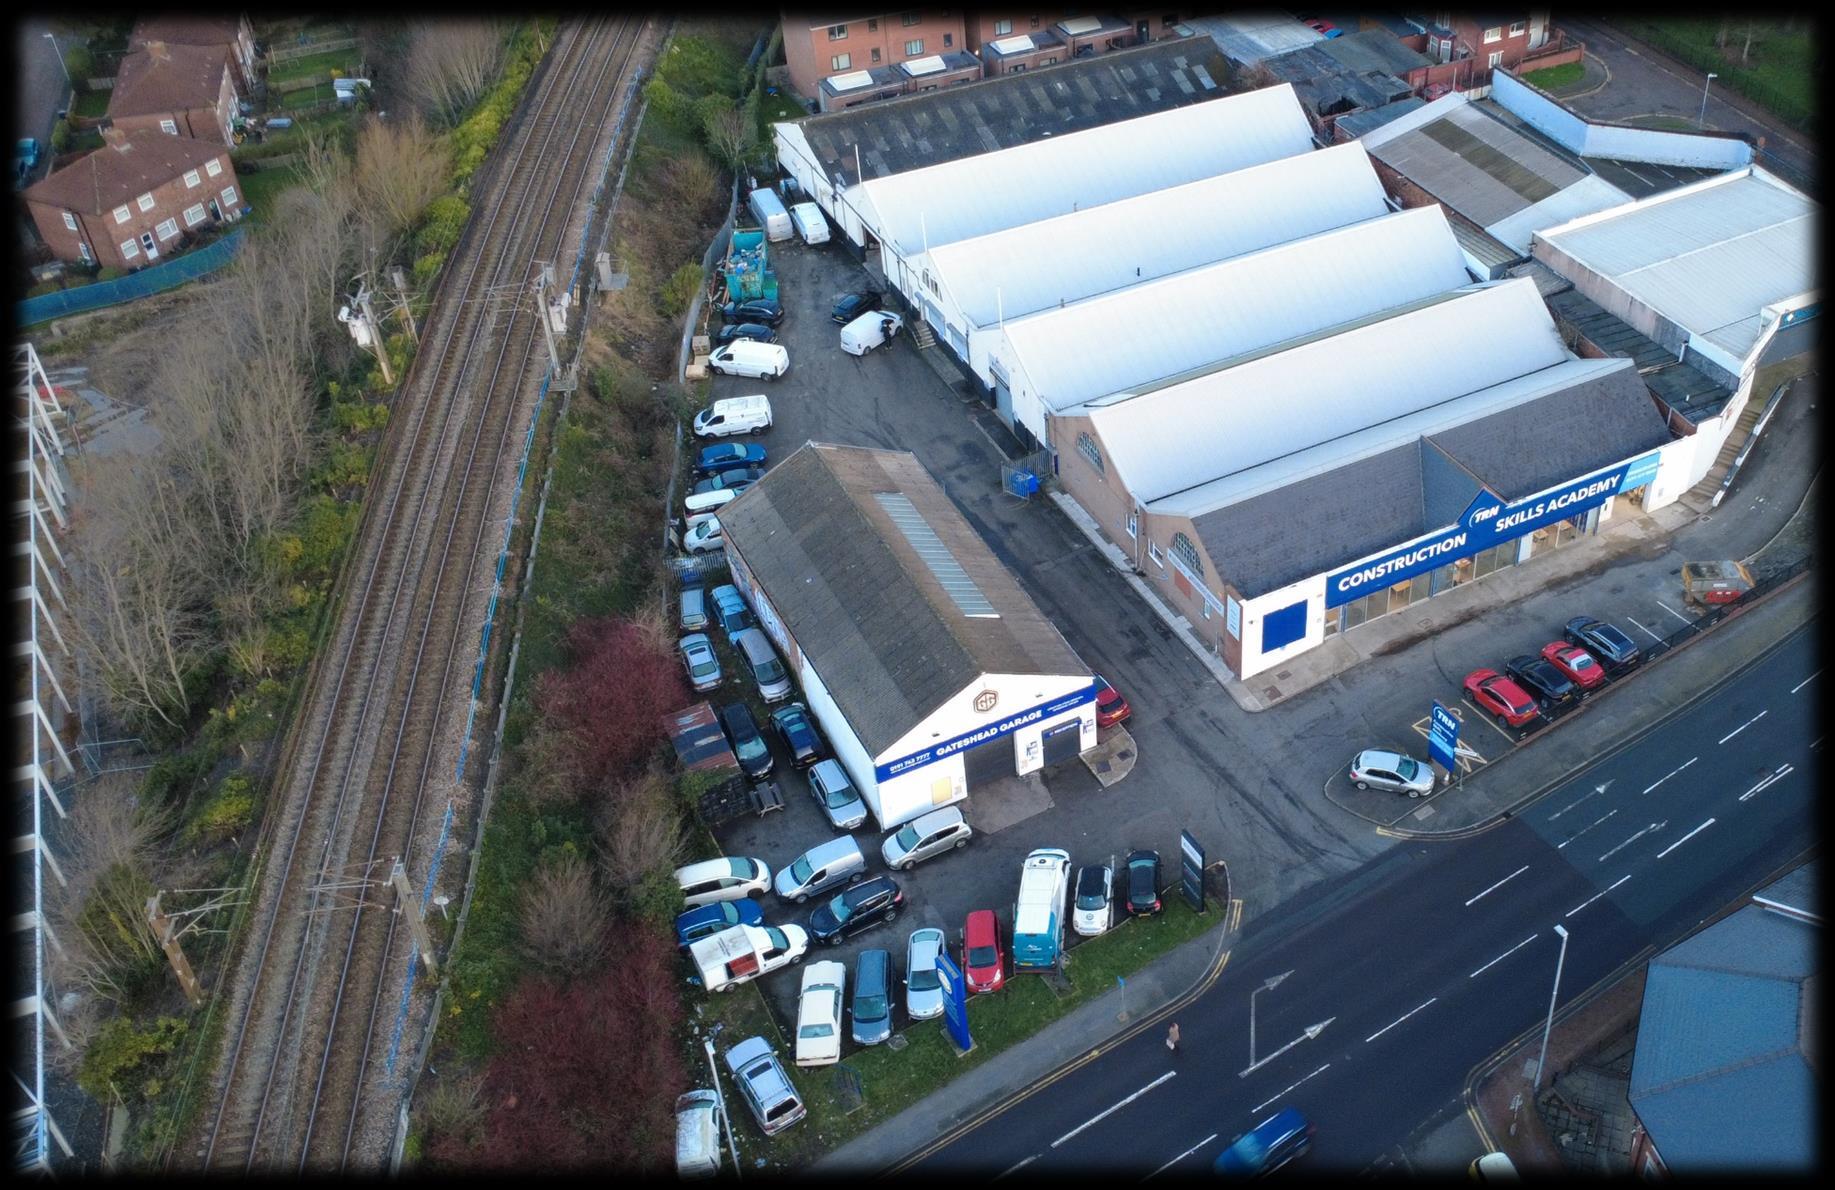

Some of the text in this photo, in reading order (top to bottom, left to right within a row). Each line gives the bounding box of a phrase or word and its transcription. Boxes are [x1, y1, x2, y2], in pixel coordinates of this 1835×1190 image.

[1474, 505, 1500, 523] TRN
[1495, 474, 1621, 533] SKILLS ACADEMY
[1338, 532, 1467, 592] CONSTRUCTION
[936, 727, 998, 756] GATESHEAD
[999, 710, 1042, 732] GARAGE
[1437, 709, 1456, 730] TRN
